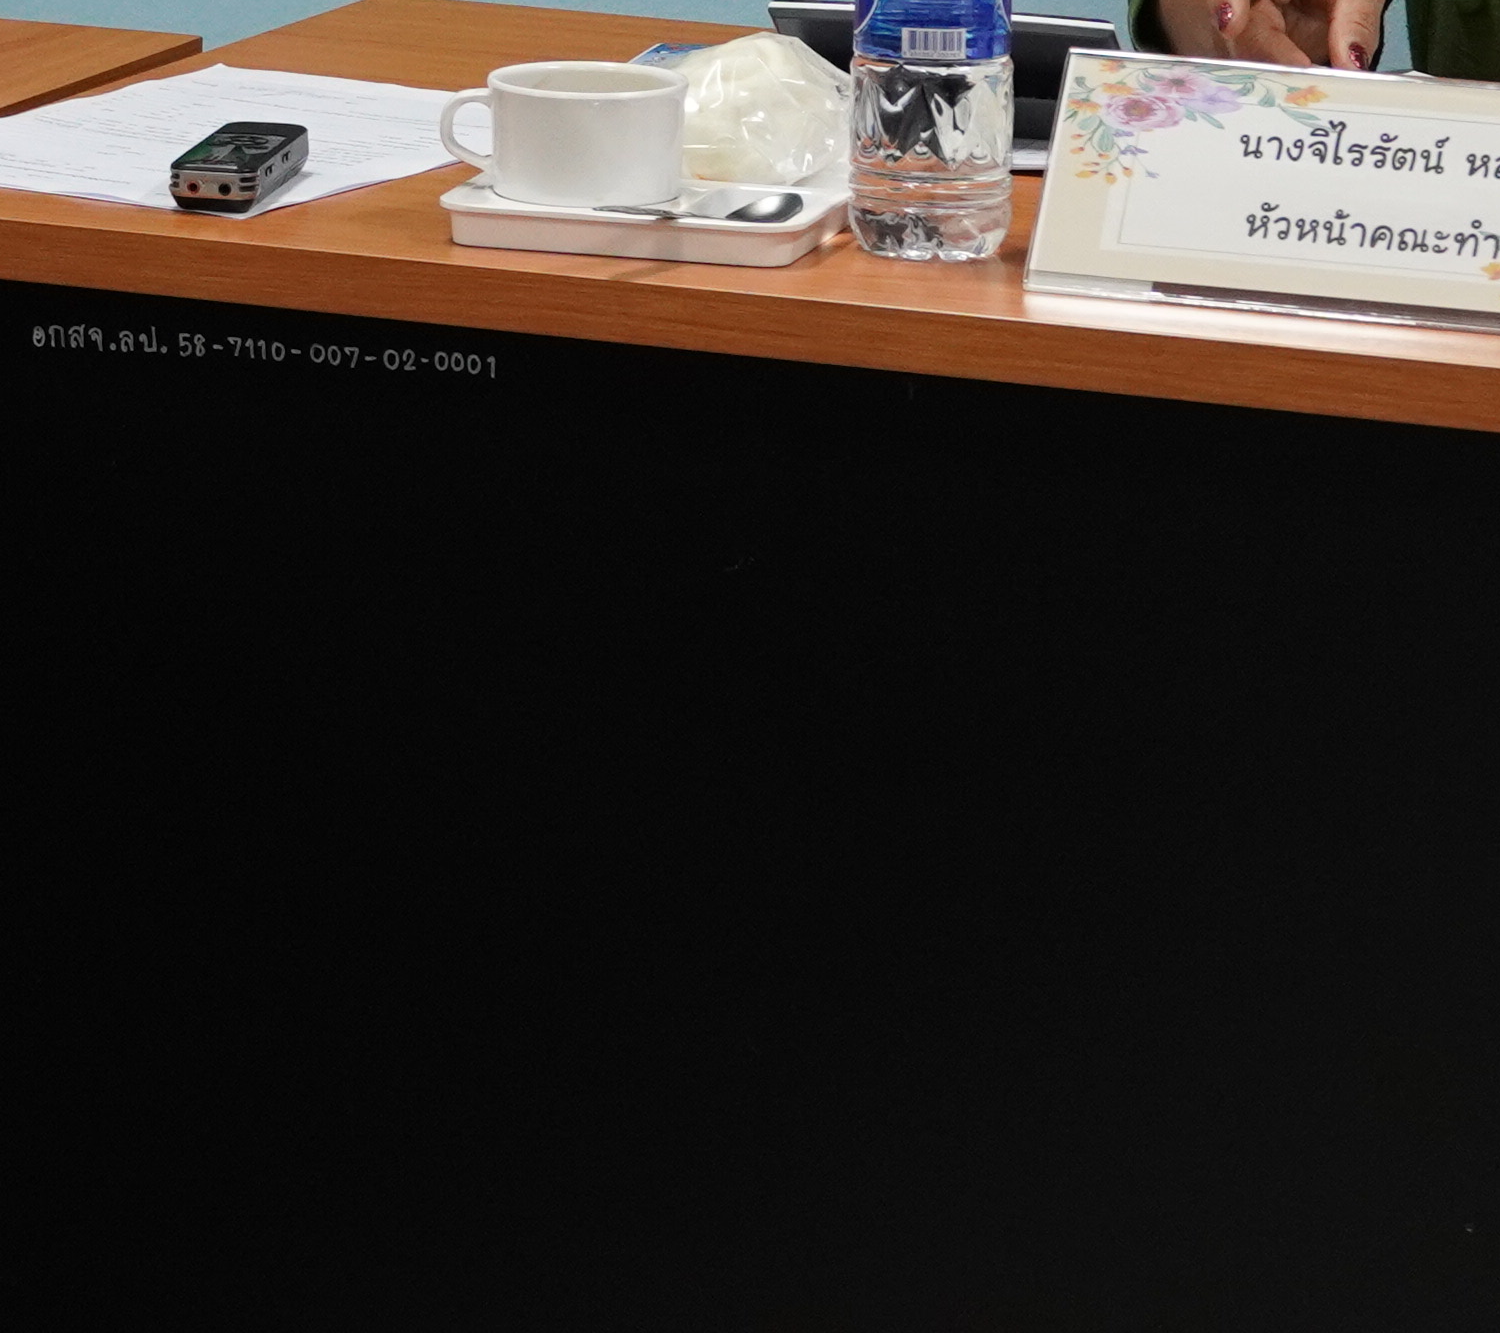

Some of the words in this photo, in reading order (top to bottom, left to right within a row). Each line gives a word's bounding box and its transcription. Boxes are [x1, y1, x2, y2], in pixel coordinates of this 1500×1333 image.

[1240, 120, 1450, 175] นางจิไรรัตน์
[178, 331, 497, 379] 58-7110-007-02-0001
